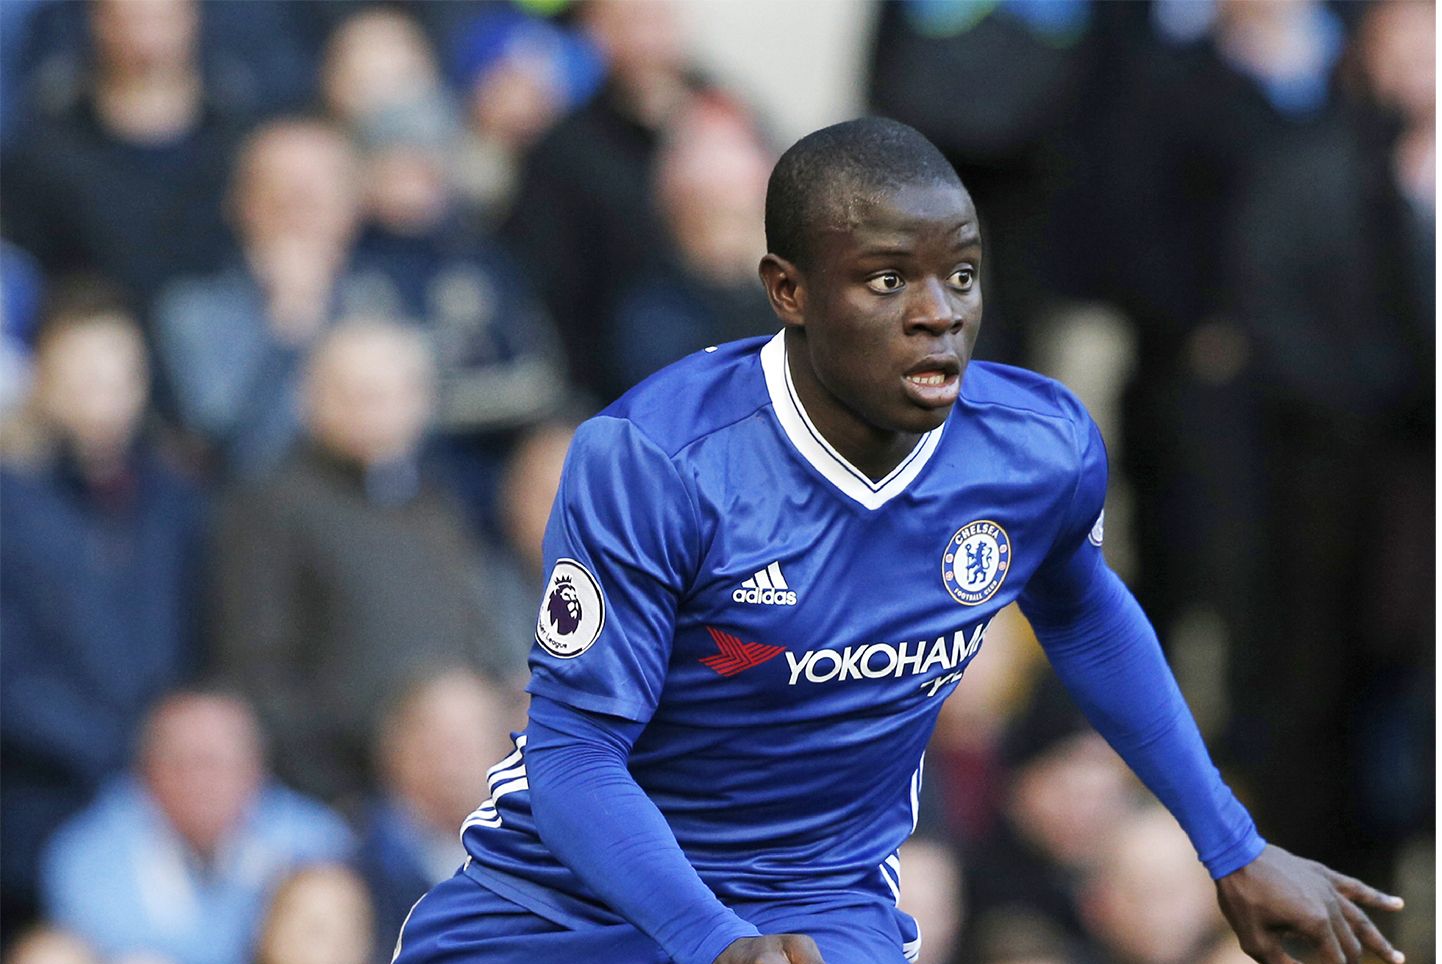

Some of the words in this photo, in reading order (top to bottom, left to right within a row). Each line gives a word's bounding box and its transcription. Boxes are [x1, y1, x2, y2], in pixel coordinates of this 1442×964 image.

[954, 524, 1000, 545] CHELSEA
[732, 586, 798, 606] adidas
[953, 587, 983, 602] FOOTBALL
